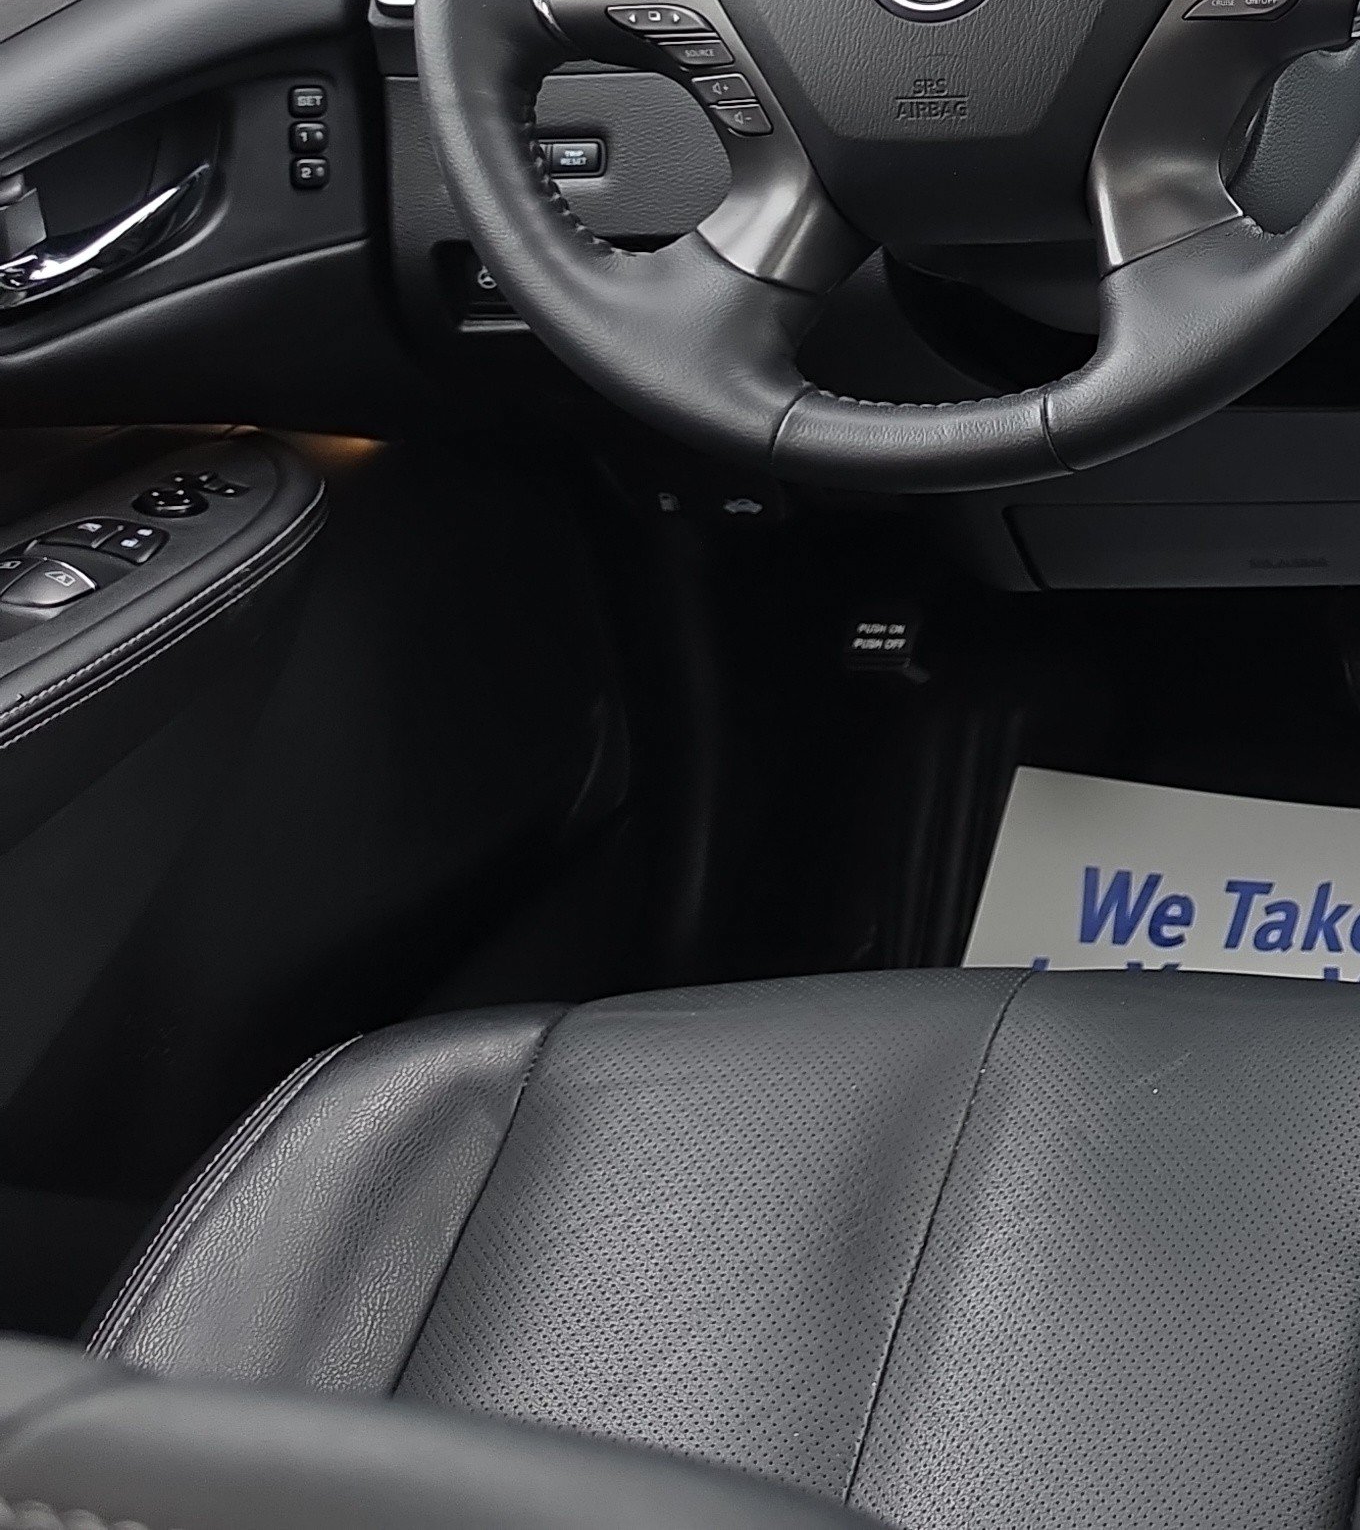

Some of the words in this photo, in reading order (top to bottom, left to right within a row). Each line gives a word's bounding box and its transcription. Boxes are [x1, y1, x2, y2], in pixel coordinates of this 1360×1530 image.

[1211, 0, 1235, 7] CRUISE
[684, 48, 715, 57] SOURCE
[912, 78, 948, 97] SRS
[297, 95, 323, 107] SET
[895, 101, 967, 120] AIRBAG
[300, 131, 308, 142] 1
[300, 167, 311, 178] 2
[1077, 865, 1196, 950] We
